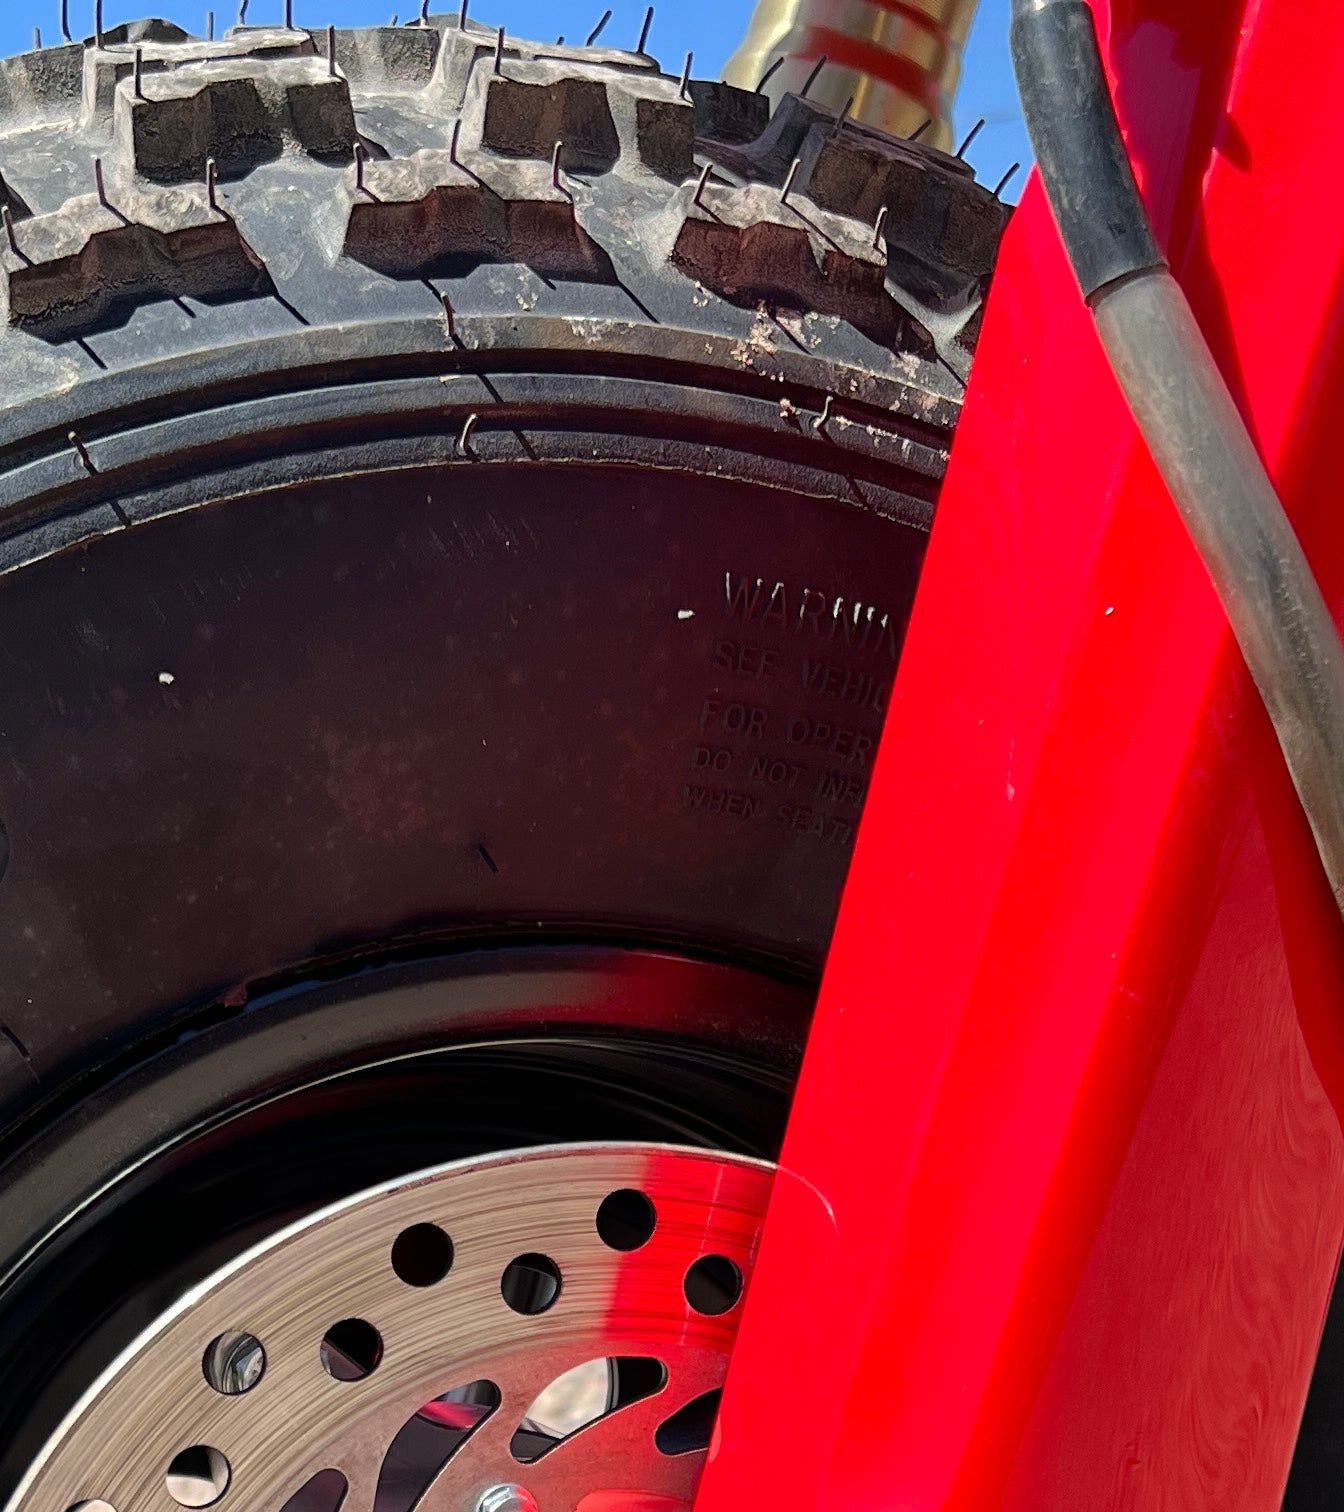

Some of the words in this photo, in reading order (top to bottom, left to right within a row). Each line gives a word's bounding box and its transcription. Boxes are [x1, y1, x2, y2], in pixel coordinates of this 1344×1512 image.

[711, 639, 780, 680] SEE
[699, 696, 769, 739] FOR
[694, 745, 734, 773] DO
[748, 753, 806, 789] NOT
[683, 783, 762, 821] WHEN
